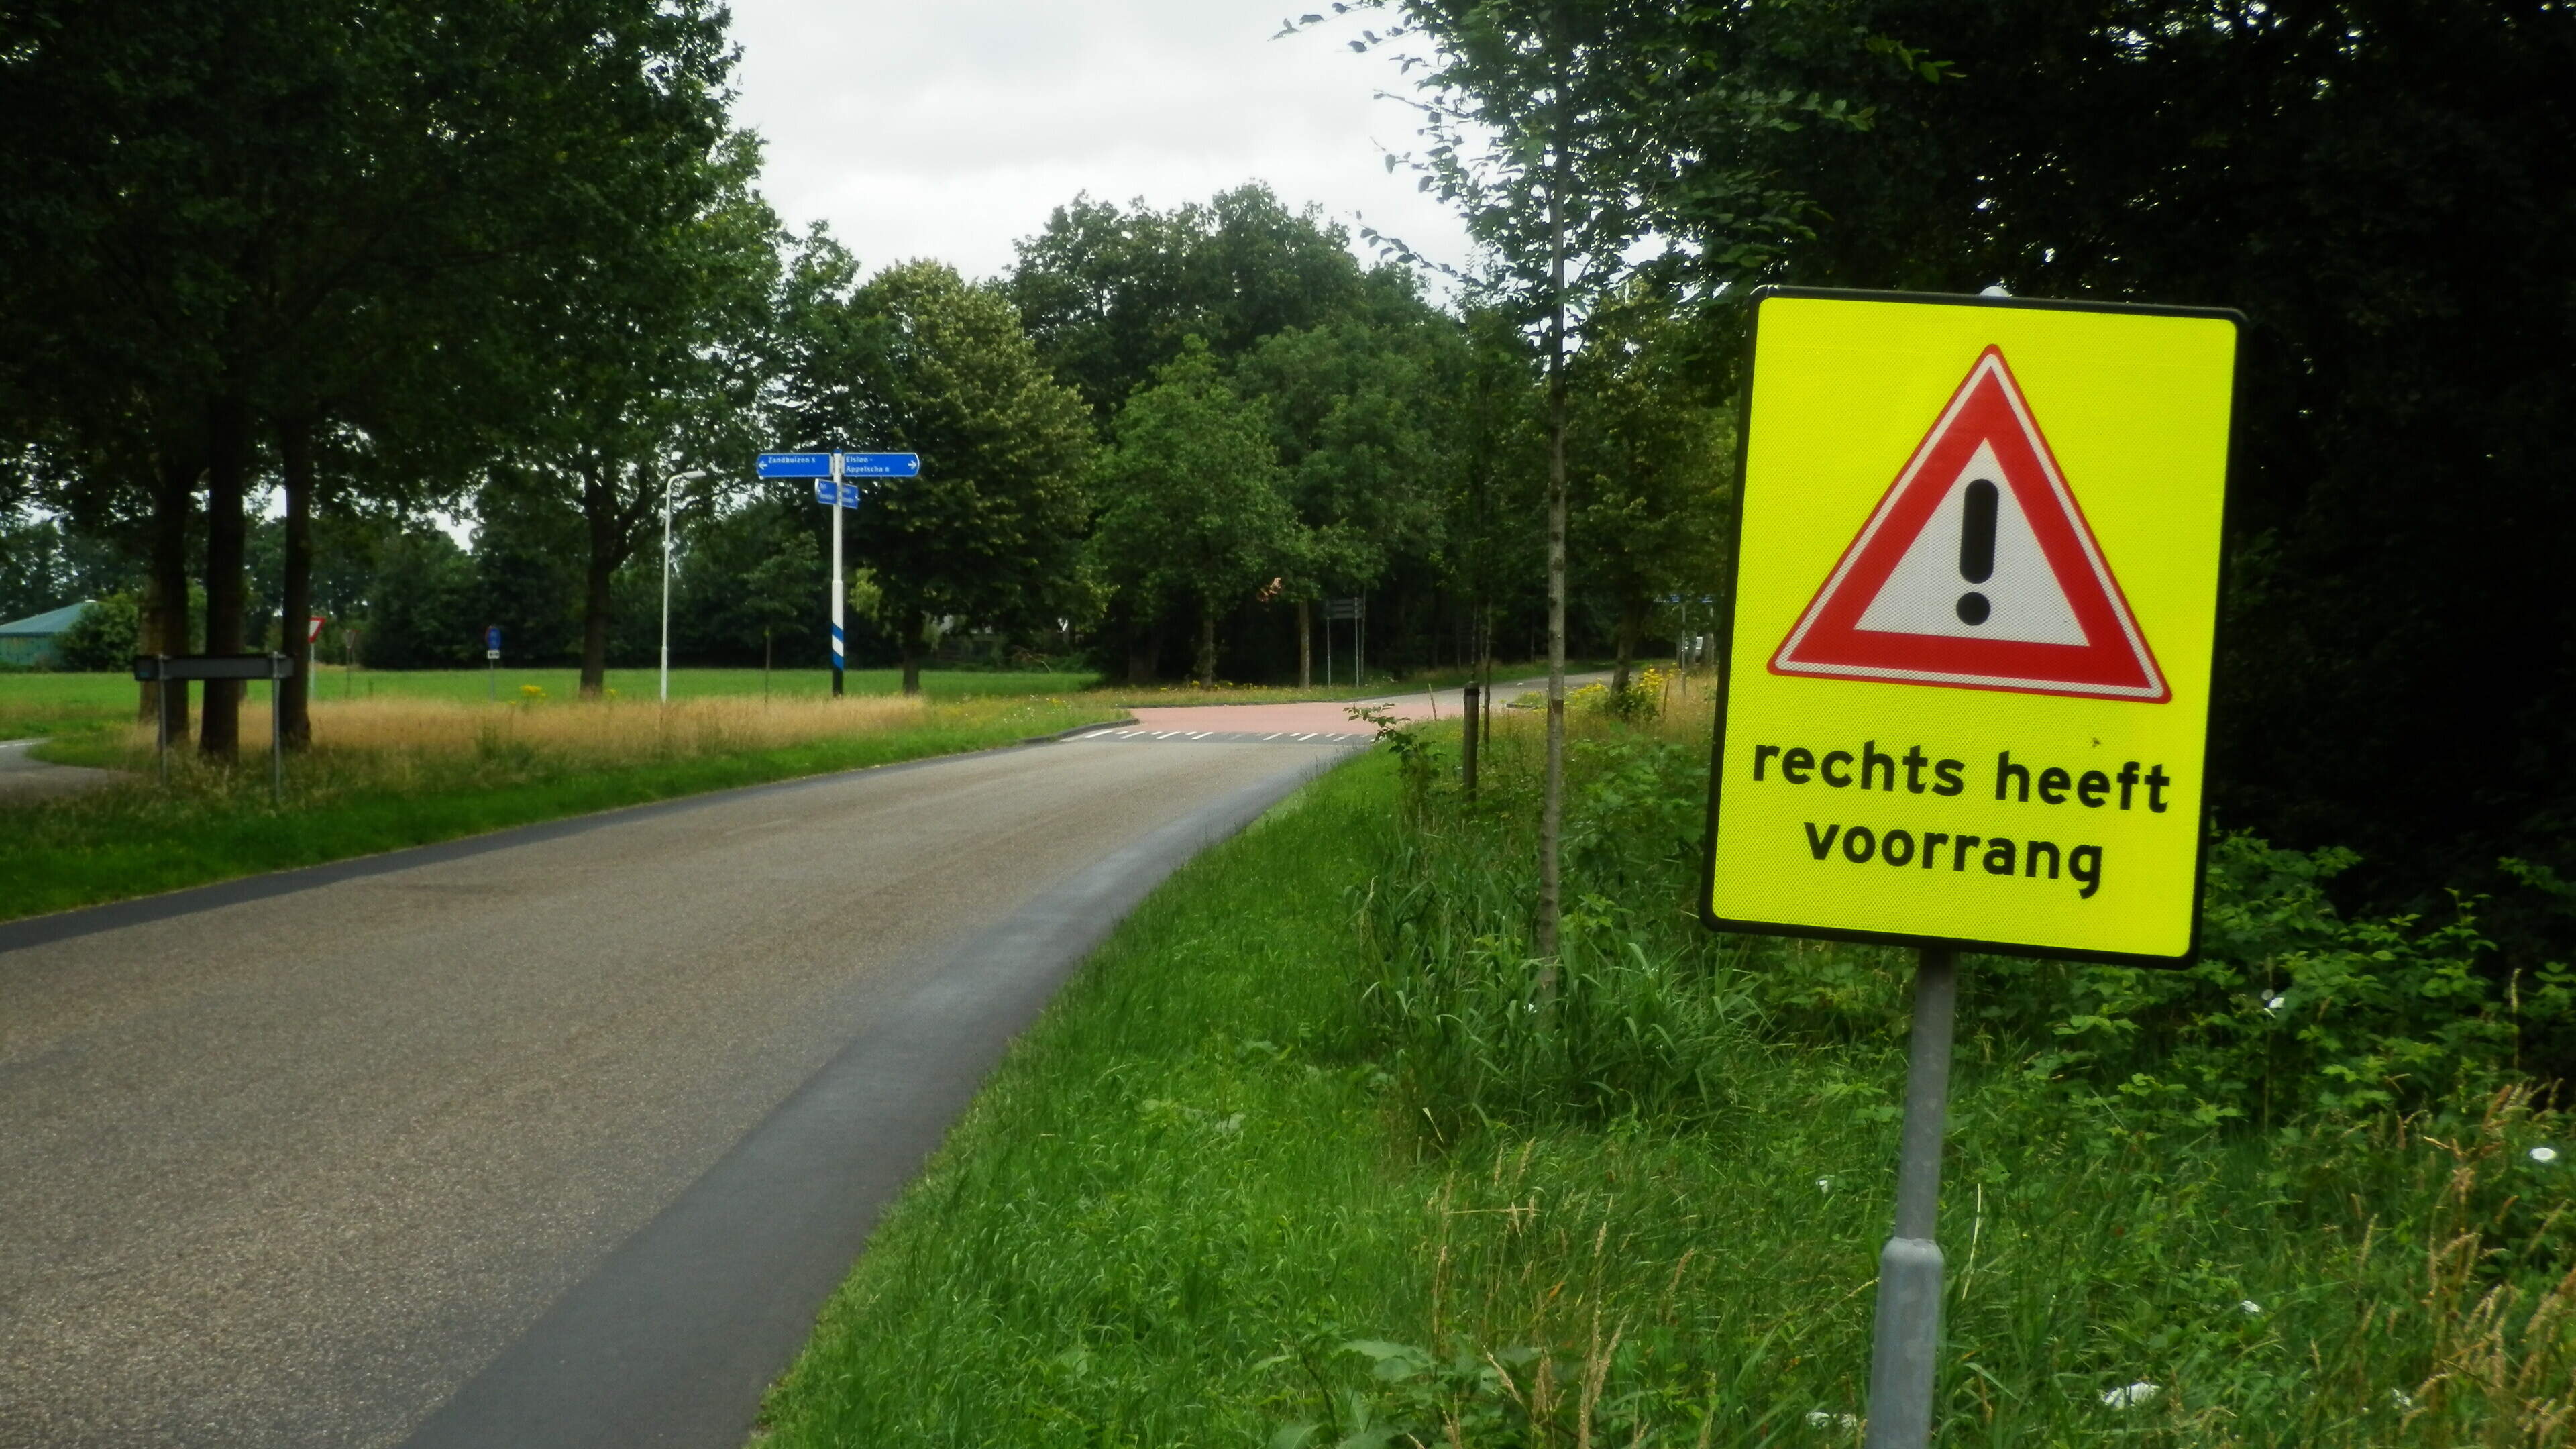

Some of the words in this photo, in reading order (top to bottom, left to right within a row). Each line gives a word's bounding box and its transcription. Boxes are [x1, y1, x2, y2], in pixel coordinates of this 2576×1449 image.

[1752, 739, 1965, 796] rechts
[1994, 750, 2170, 813] heeft
[1803, 822, 2102, 900] voorrang
